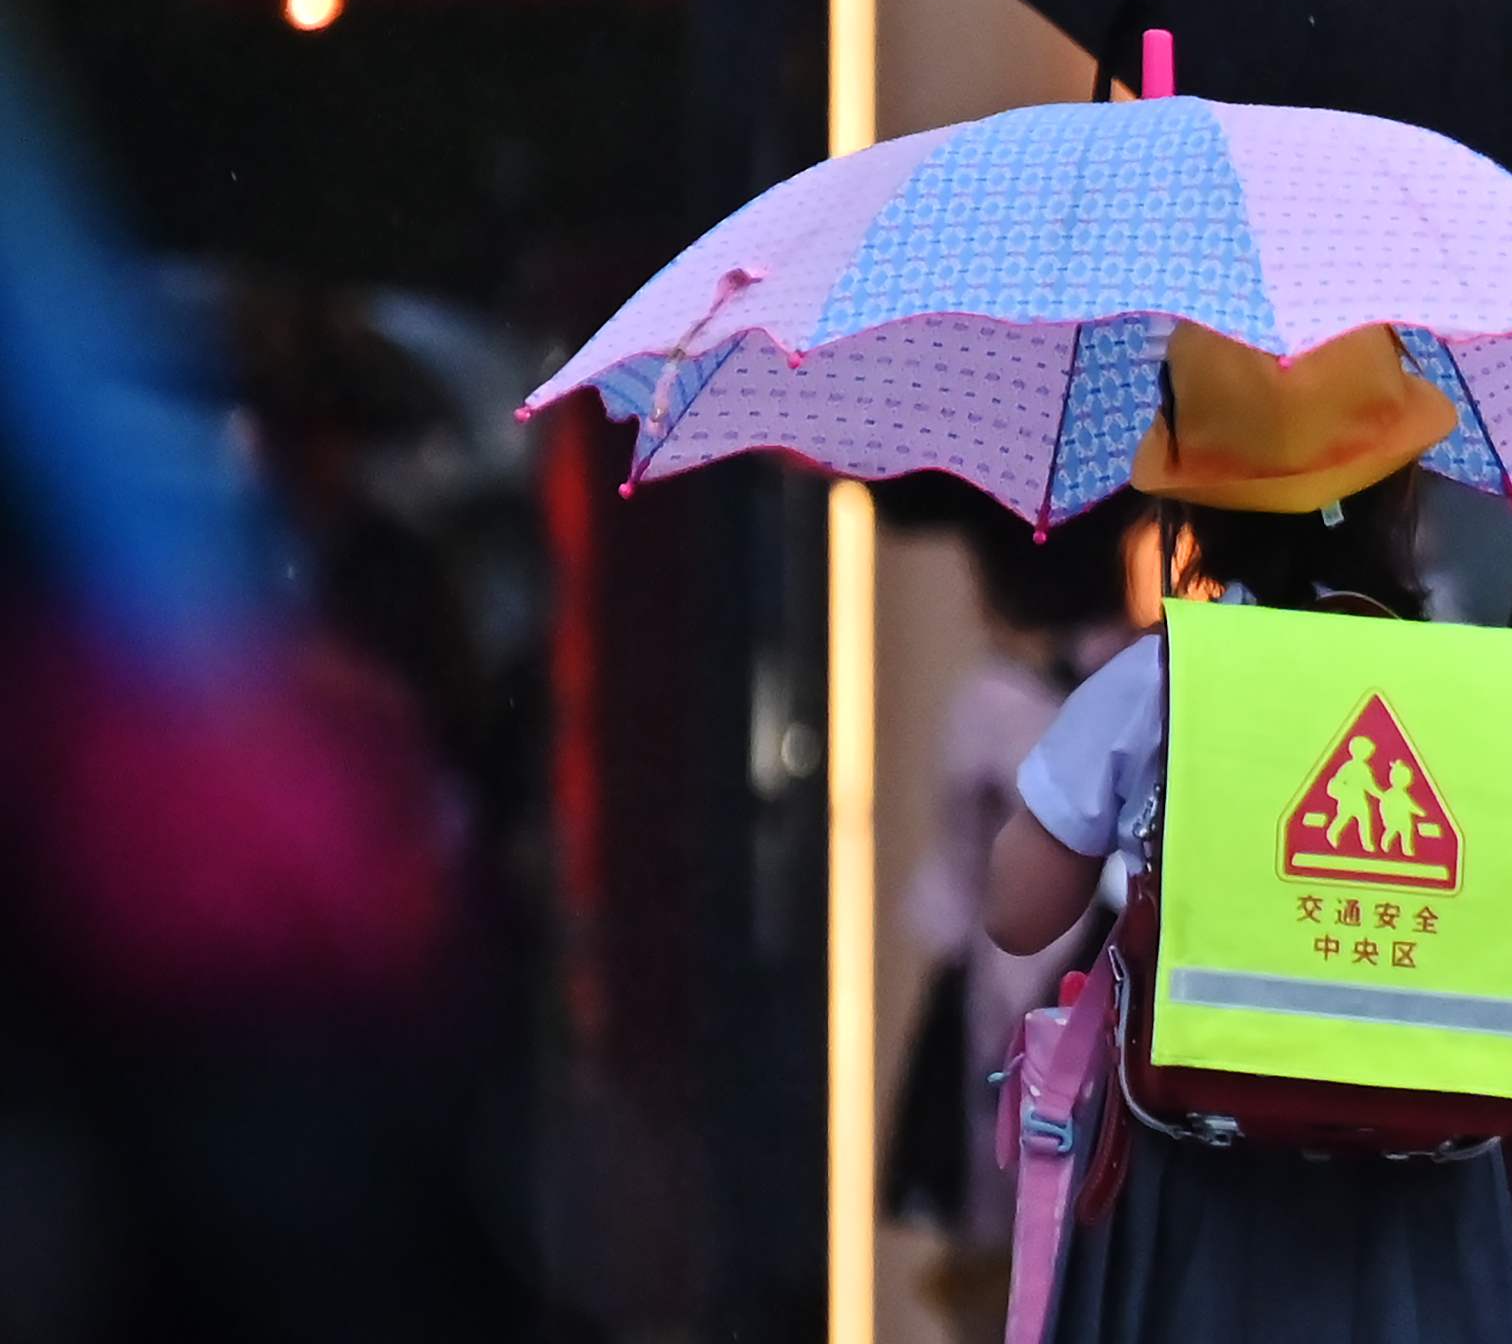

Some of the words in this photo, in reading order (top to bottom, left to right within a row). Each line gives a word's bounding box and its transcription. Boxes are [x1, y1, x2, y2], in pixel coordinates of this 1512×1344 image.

[1296, 895, 1439, 935] 交通安全
[1314, 933, 1417, 969] 中央区
